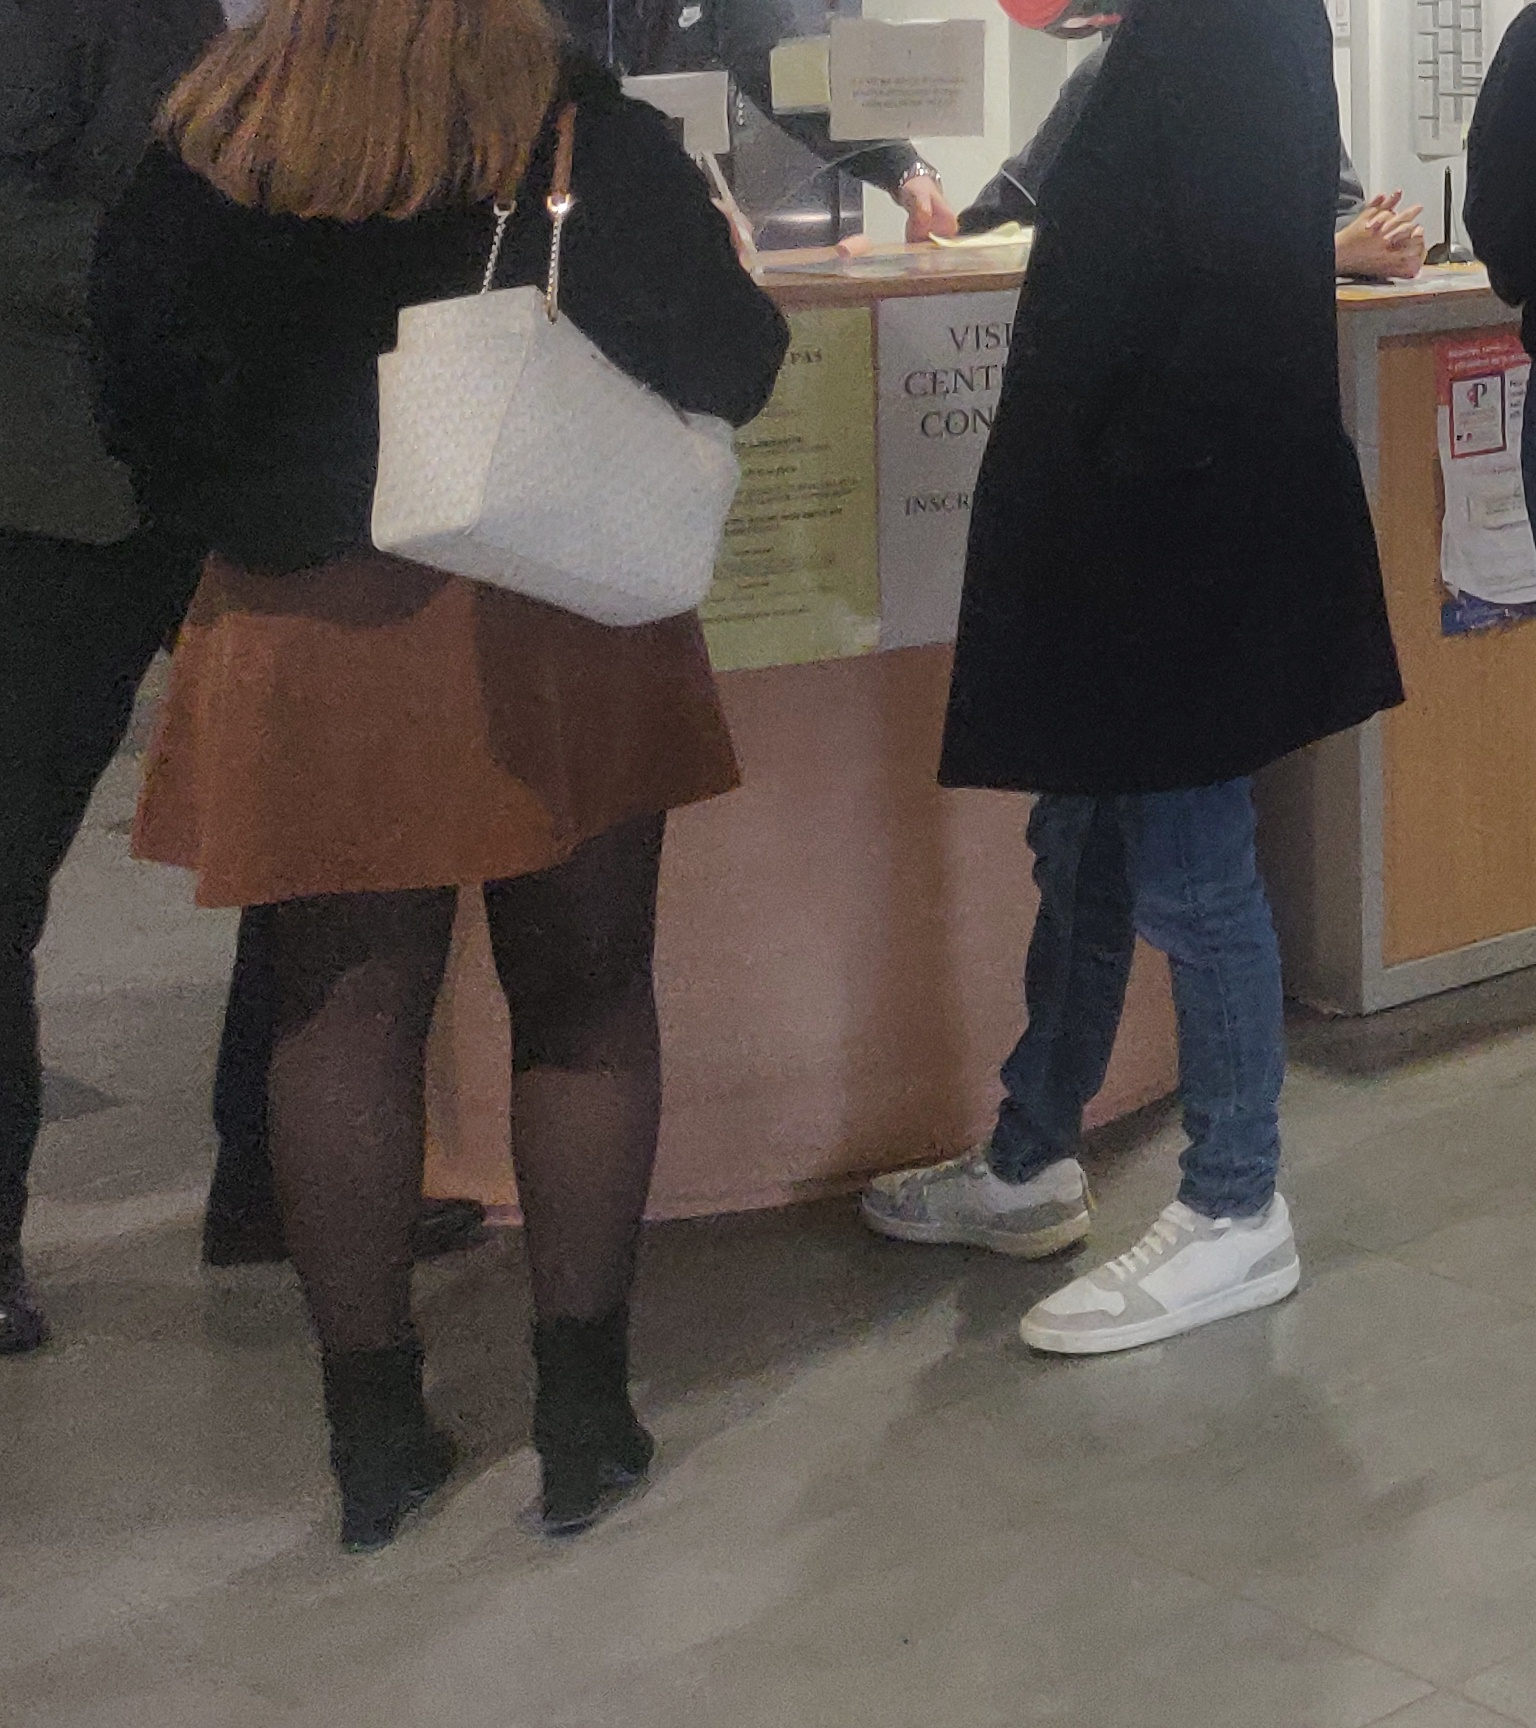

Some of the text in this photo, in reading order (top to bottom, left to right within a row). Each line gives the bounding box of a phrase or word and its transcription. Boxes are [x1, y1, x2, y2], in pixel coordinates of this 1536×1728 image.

[949, 322, 1013, 352] VISI
[904, 364, 1005, 398] CENT
[920, 407, 994, 439] CON
[905, 492, 969, 515] INSCR
